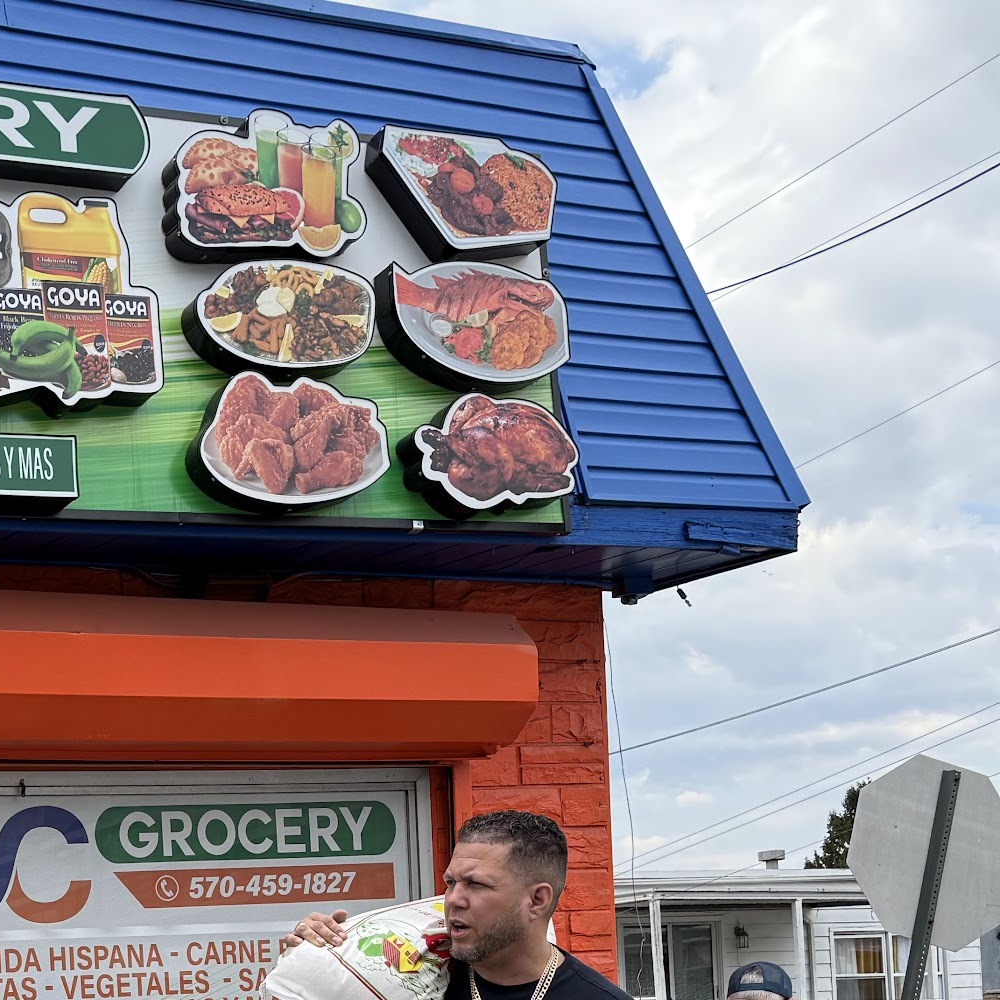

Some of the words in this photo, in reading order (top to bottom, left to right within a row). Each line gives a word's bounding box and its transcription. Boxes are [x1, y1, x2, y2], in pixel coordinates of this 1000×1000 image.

[47, 285, 101, 307] GOYA
[105, 299, 148, 317] GOYA
[3, 446, 15, 479] Y
[18, 447, 54, 481] MAS
[118, 805, 374, 859] GROCERY
[188, 870, 357, 899] 570-459-1827
[49, 943, 164, 971] HISPANA
[186, 939, 272, 966] CARNE
[61, 970, 210, 1000] VEGETALES
